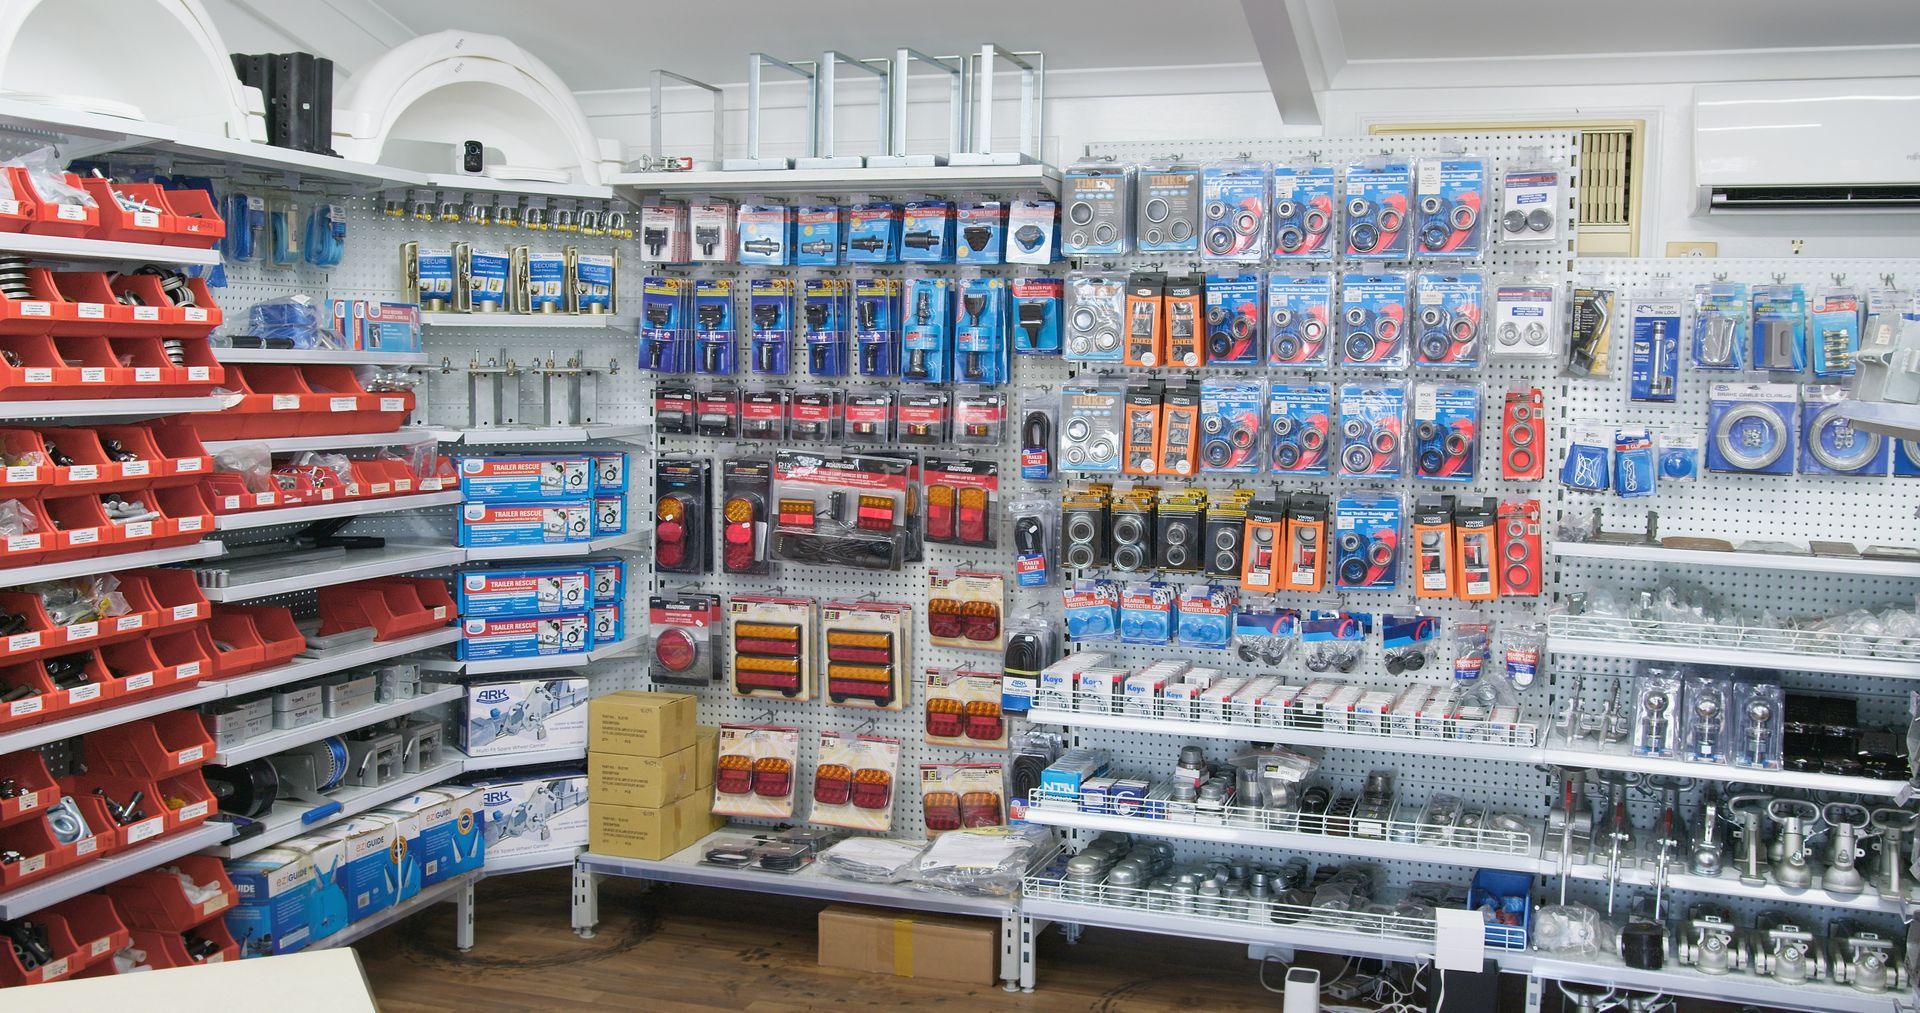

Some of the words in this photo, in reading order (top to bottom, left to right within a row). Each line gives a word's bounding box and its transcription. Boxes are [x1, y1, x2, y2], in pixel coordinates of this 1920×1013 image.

[1072, 396, 1107, 405] TIMKE
[1044, 674, 1063, 684] Koyo
[1127, 684, 1145, 693] Koyo
[479, 689, 508, 699] ARK
[1044, 781, 1074, 792] NTN
[426, 808, 451, 821] eziGUIDE
[356, 836, 384, 852] eziGUIDE
[277, 868, 307, 886] eziGUIDE
[234, 884, 255, 892] UIDE
